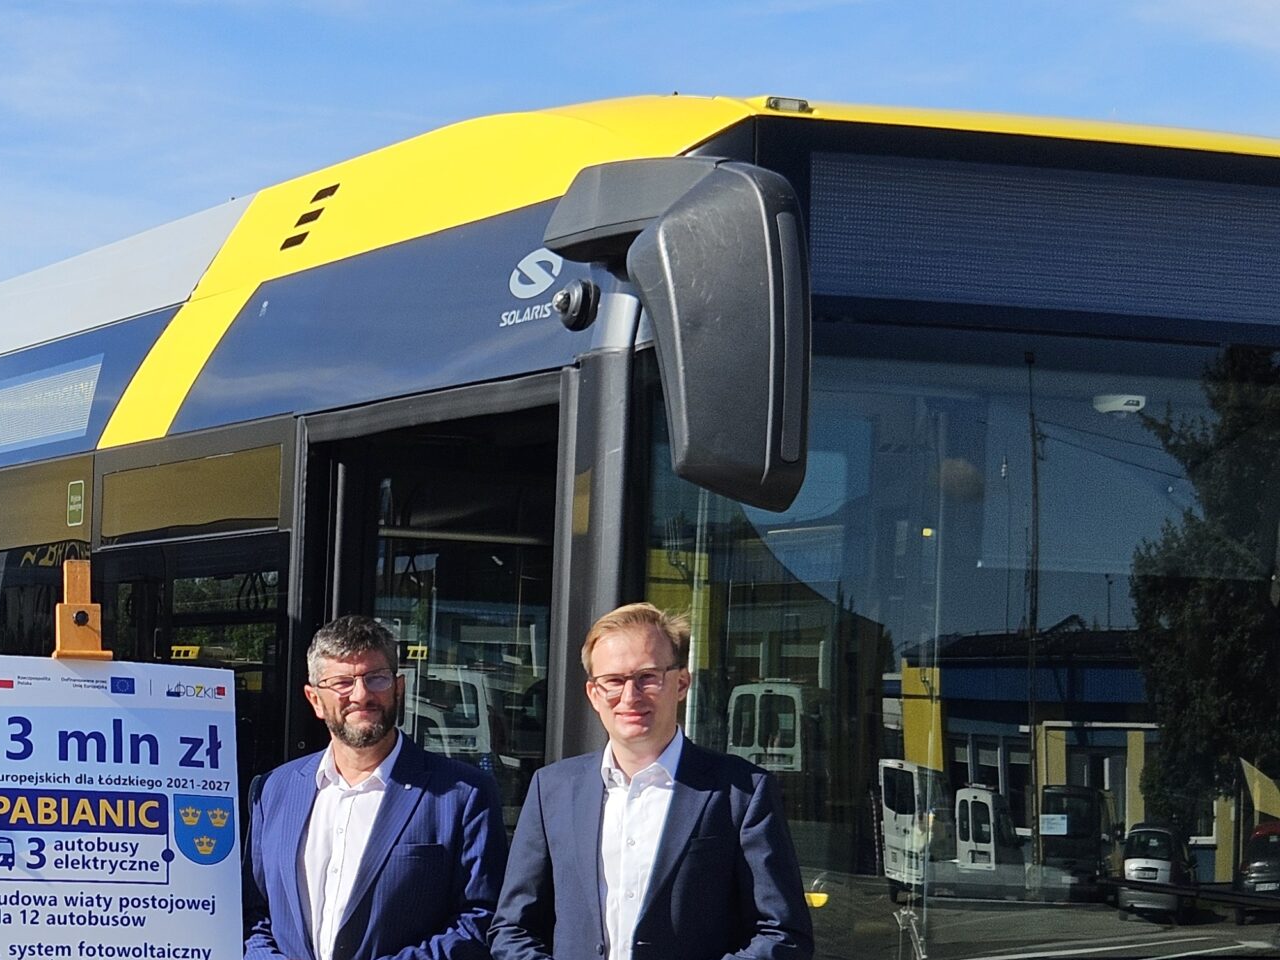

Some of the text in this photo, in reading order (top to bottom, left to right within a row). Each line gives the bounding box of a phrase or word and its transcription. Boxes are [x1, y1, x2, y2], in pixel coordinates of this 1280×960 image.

[499, 302, 553, 327] SOLARIS
[58, 718, 159, 765] mln
[179, 724, 222, 769] zł
[75, 773, 94, 785] dla
[98, 774, 162, 789] Łódzkiego
[166, 777, 230, 791] 2021-2027
[26, 837, 46, 869] 3
[53, 836, 139, 856] autobusy
[53, 857, 160, 874] elektryczne
[64, 891, 113, 911] wiaty
[119, 894, 216, 914] postojowej
[20, 910, 39, 925] 12
[46, 910, 146, 927] autobusów
[9, 943, 71, 958] system
